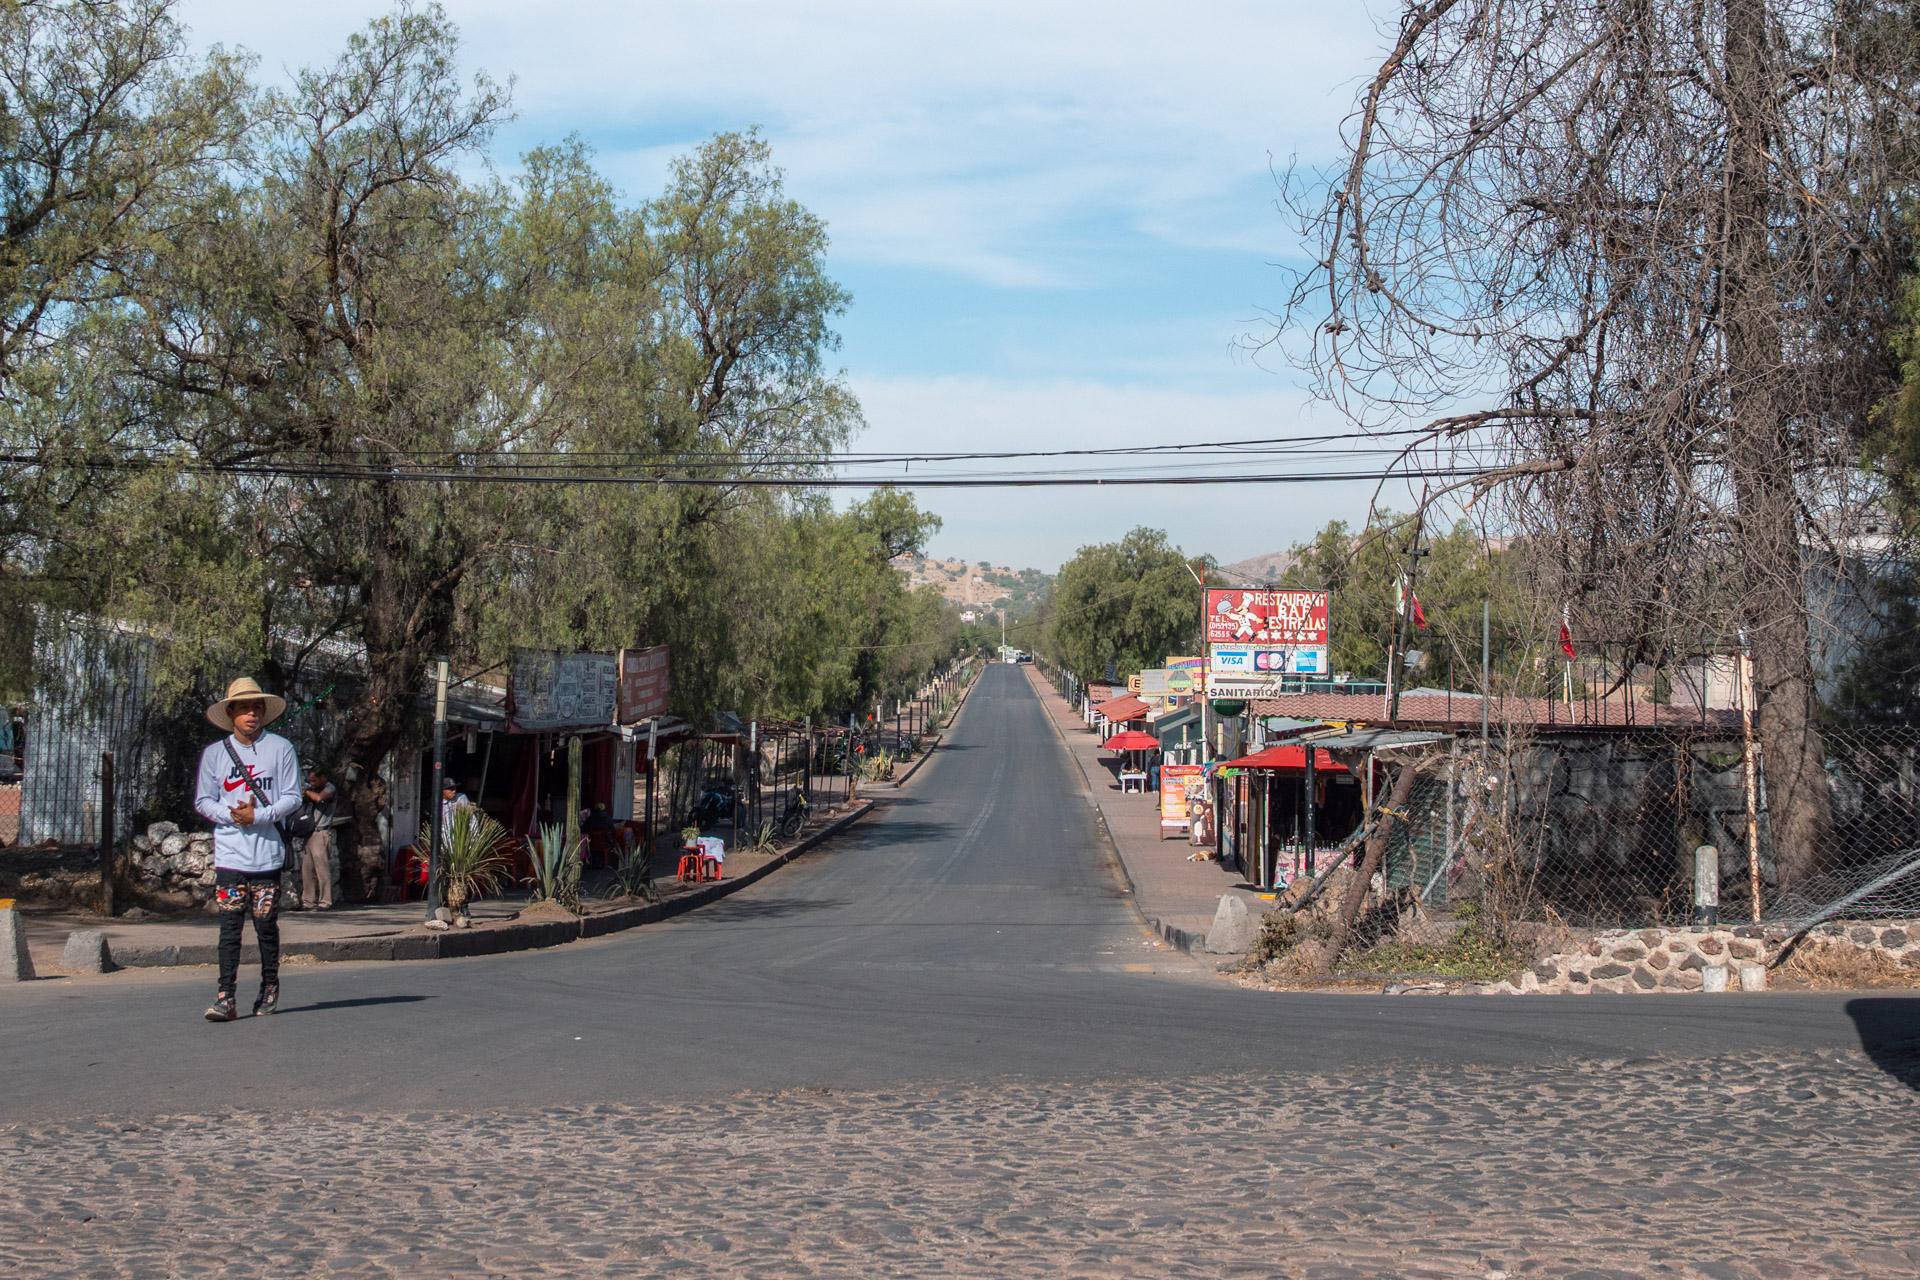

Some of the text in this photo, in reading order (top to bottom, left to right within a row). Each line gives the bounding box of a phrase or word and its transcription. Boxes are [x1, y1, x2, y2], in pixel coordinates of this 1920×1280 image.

[1255, 593, 1325, 607] RESTAURANT
[1279, 605, 1311, 620] BAR
[1269, 616, 1326, 630] ESTRELLAS
[1221, 657, 1243, 665] VISA
[1210, 688, 1279, 697] SANITARIOS
[229, 765, 255, 780] JUT
